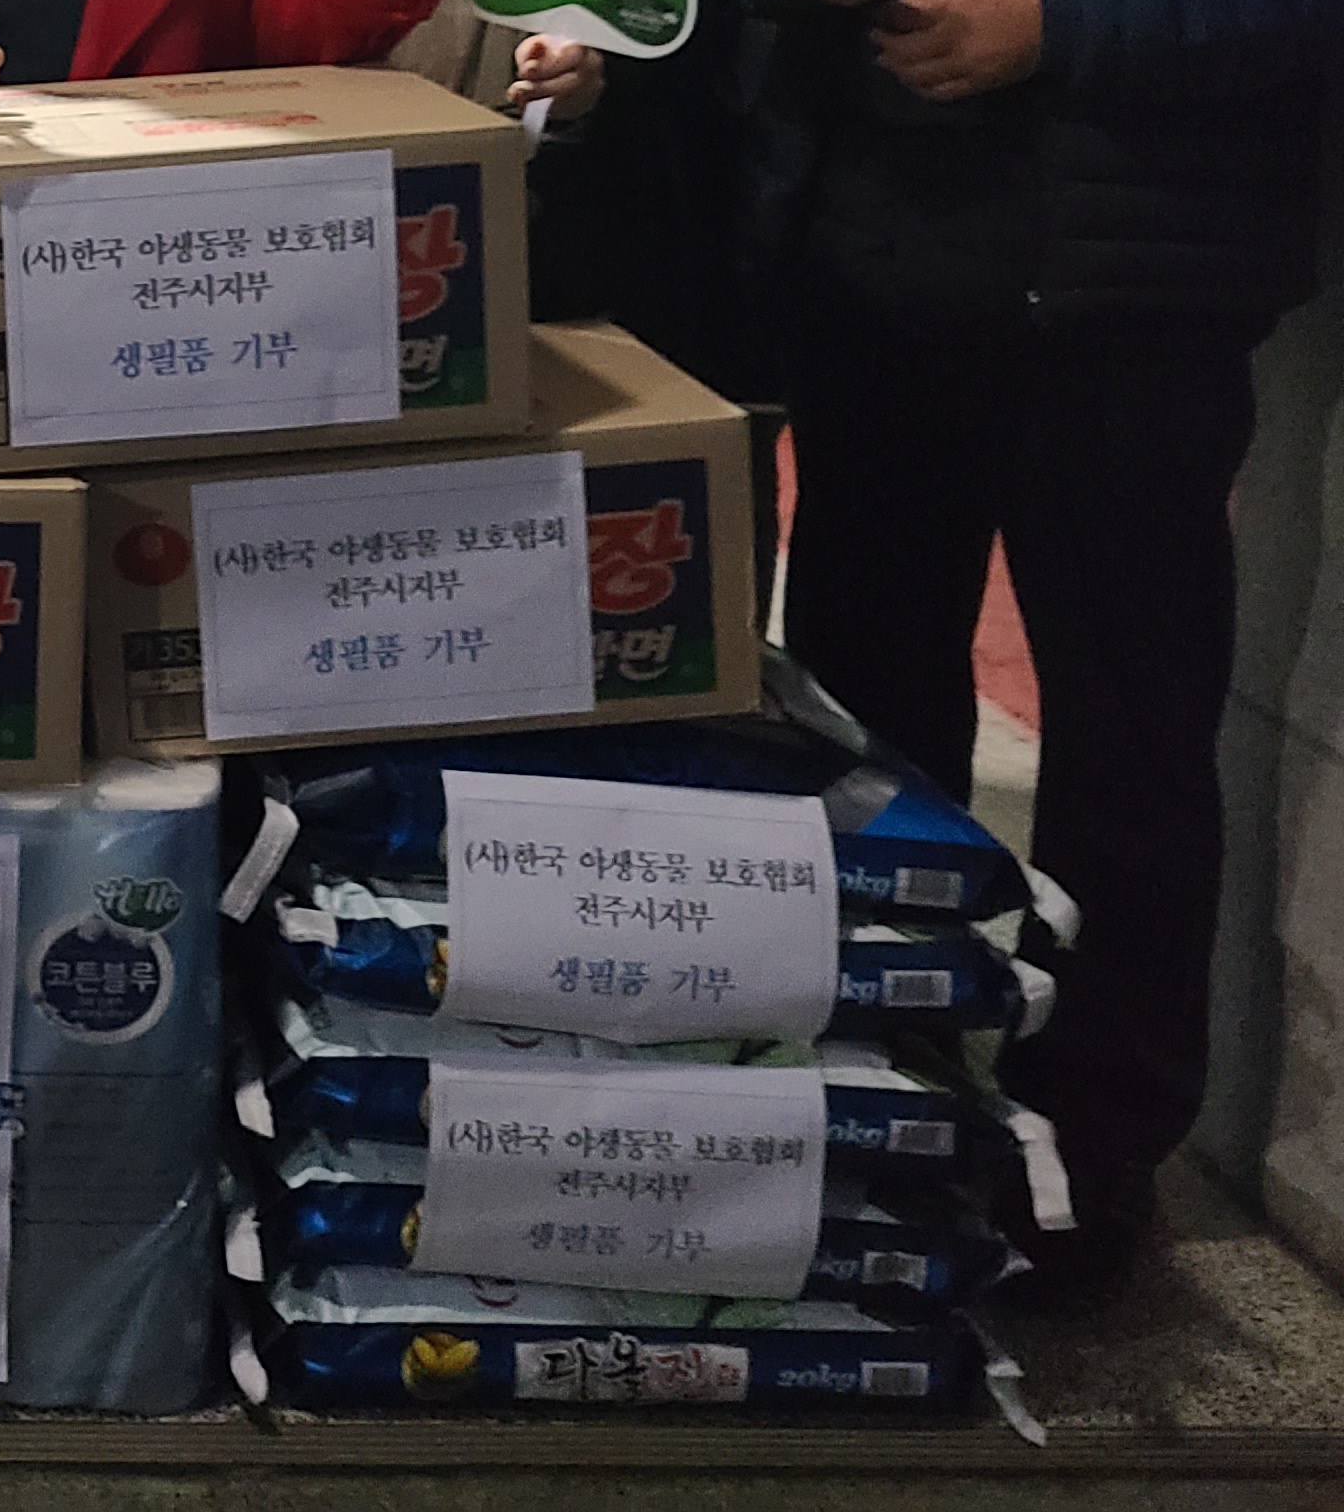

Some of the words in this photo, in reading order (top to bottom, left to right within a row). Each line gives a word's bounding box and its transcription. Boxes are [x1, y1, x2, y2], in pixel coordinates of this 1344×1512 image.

[23, 238, 126, 275] (사)한국
[138, 228, 252, 265] 야생동물
[264, 217, 374, 253] 보호협회
[133, 271, 273, 309] 전주시지부
[112, 338, 213, 378] 생필품
[233, 331, 298, 369] 기부
